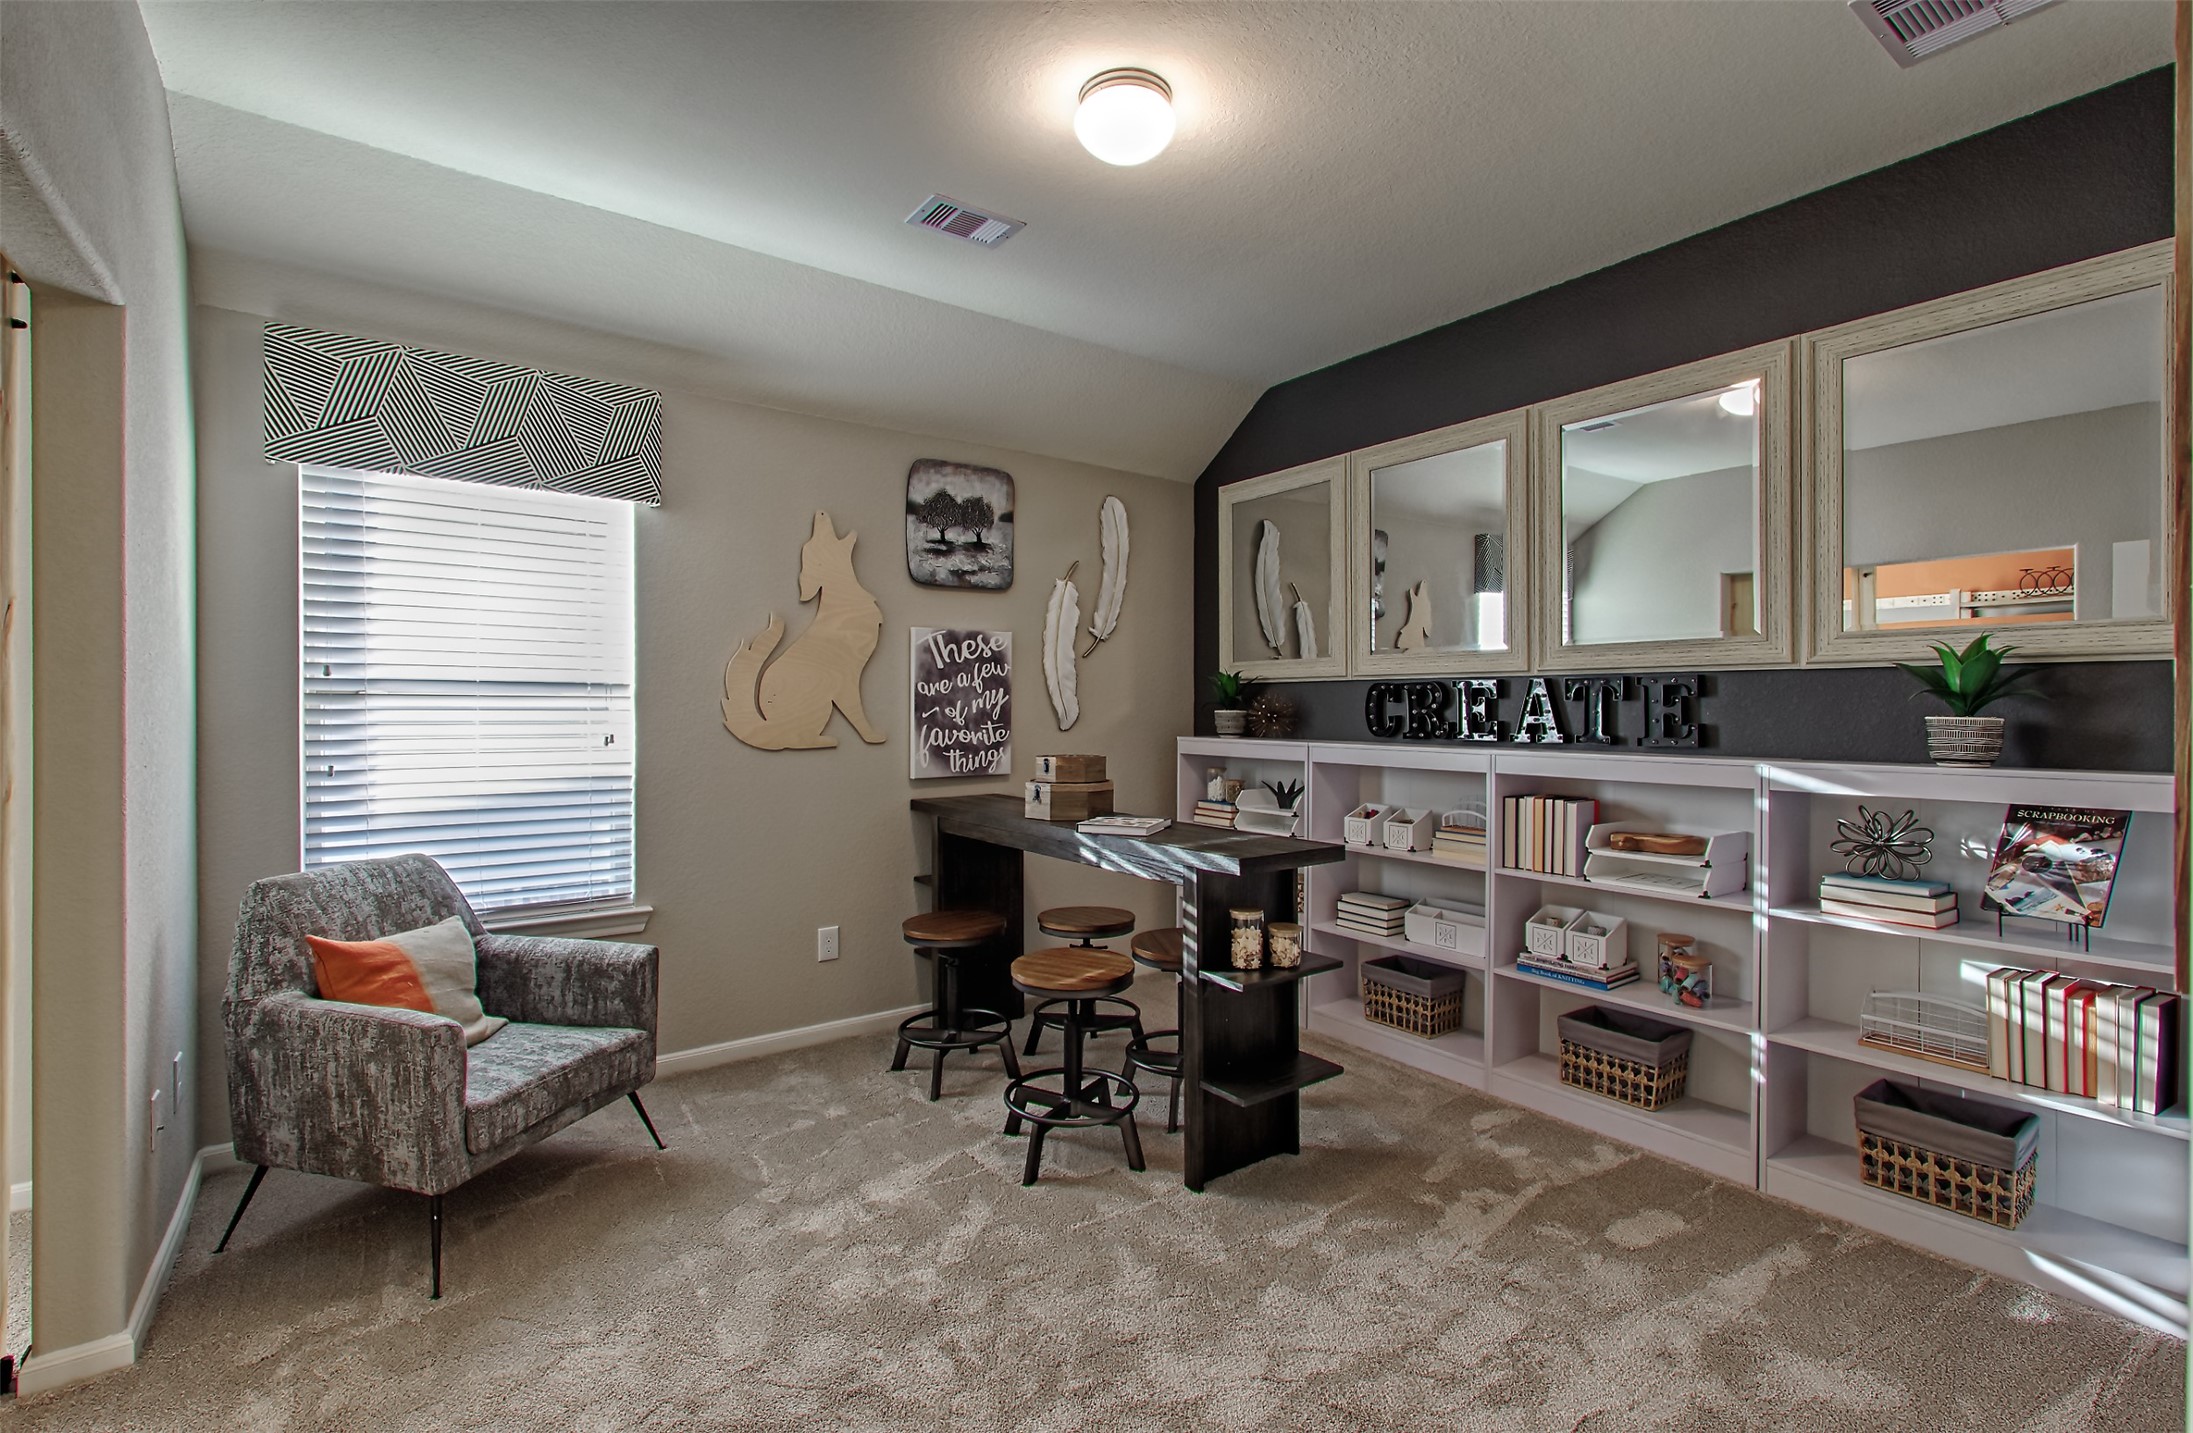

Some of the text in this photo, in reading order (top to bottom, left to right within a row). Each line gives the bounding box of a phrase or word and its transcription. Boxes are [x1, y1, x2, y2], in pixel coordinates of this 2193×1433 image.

[916, 630, 1008, 669] These
[917, 661, 1011, 697] are a few
[944, 687, 1009, 726] of my
[1364, 677, 1700, 748] CREATE
[919, 720, 1010, 768] favorite
[942, 747, 1004, 773] things
[2017, 809, 2115, 825] SCRAPBOOKING
[1557, 974, 1585, 985] KNITTING
